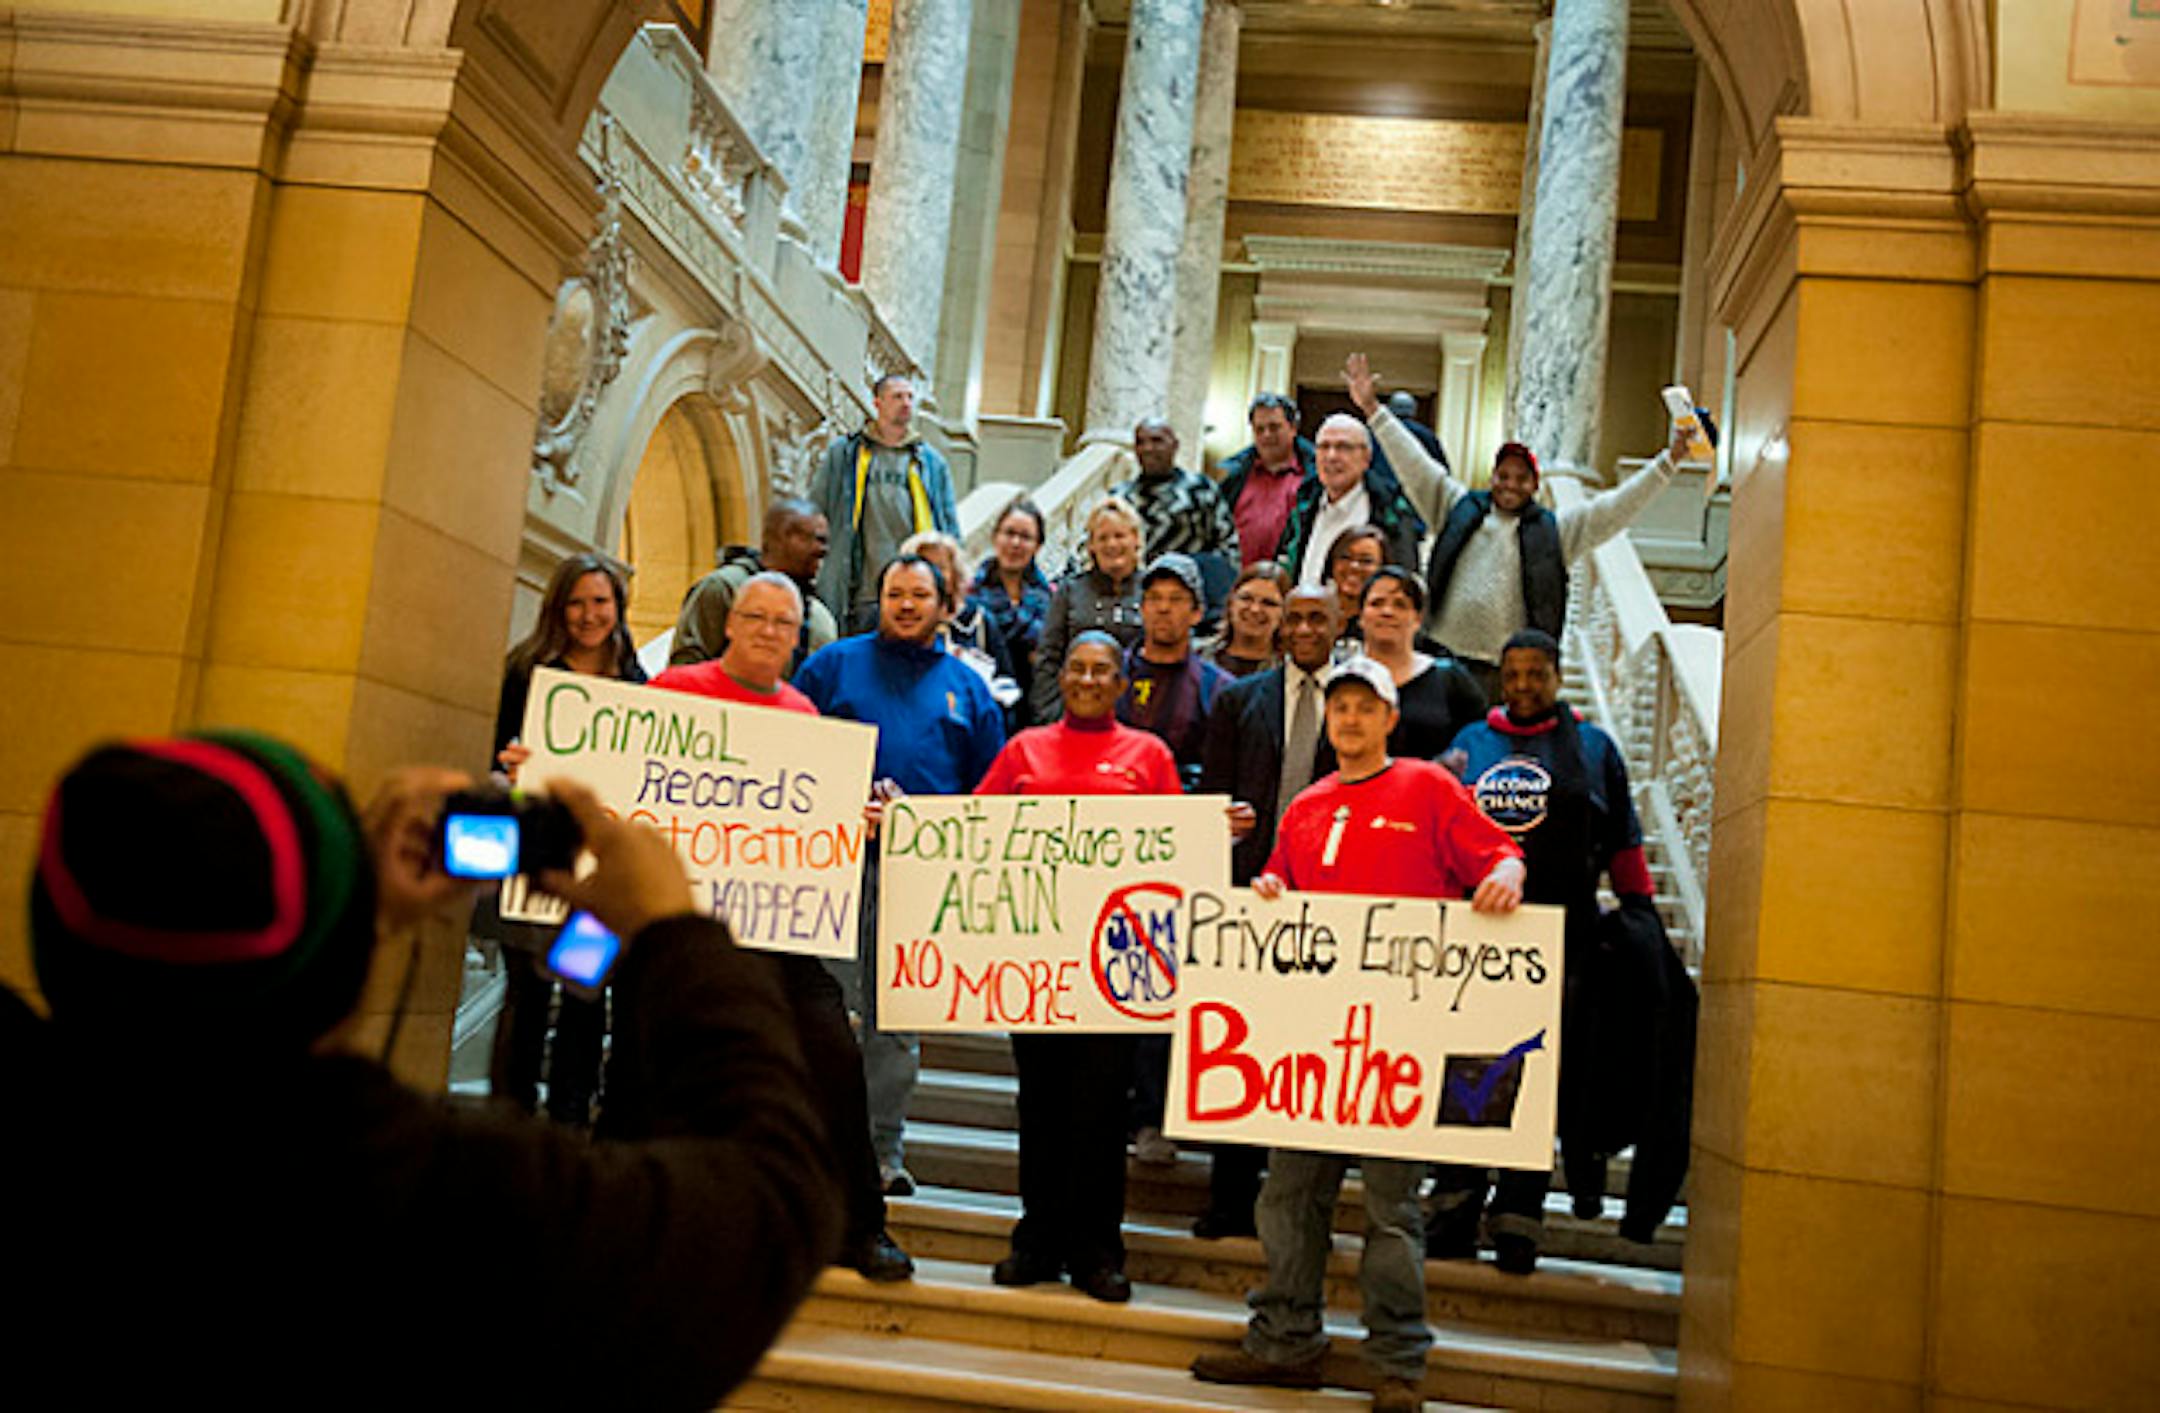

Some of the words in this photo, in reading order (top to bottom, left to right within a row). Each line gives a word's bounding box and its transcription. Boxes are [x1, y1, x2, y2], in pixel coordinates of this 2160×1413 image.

[1135, 826, 1175, 864] us
[931, 864, 1063, 935] AGAIN
[891, 939, 944, 989] NO
[946, 960, 1081, 1026] MORE
[1182, 890, 1338, 976] Private
[1359, 899, 1548, 1012] Employers
[1186, 1000, 1328, 1123] Ban
[1331, 1003, 1425, 1130] the
